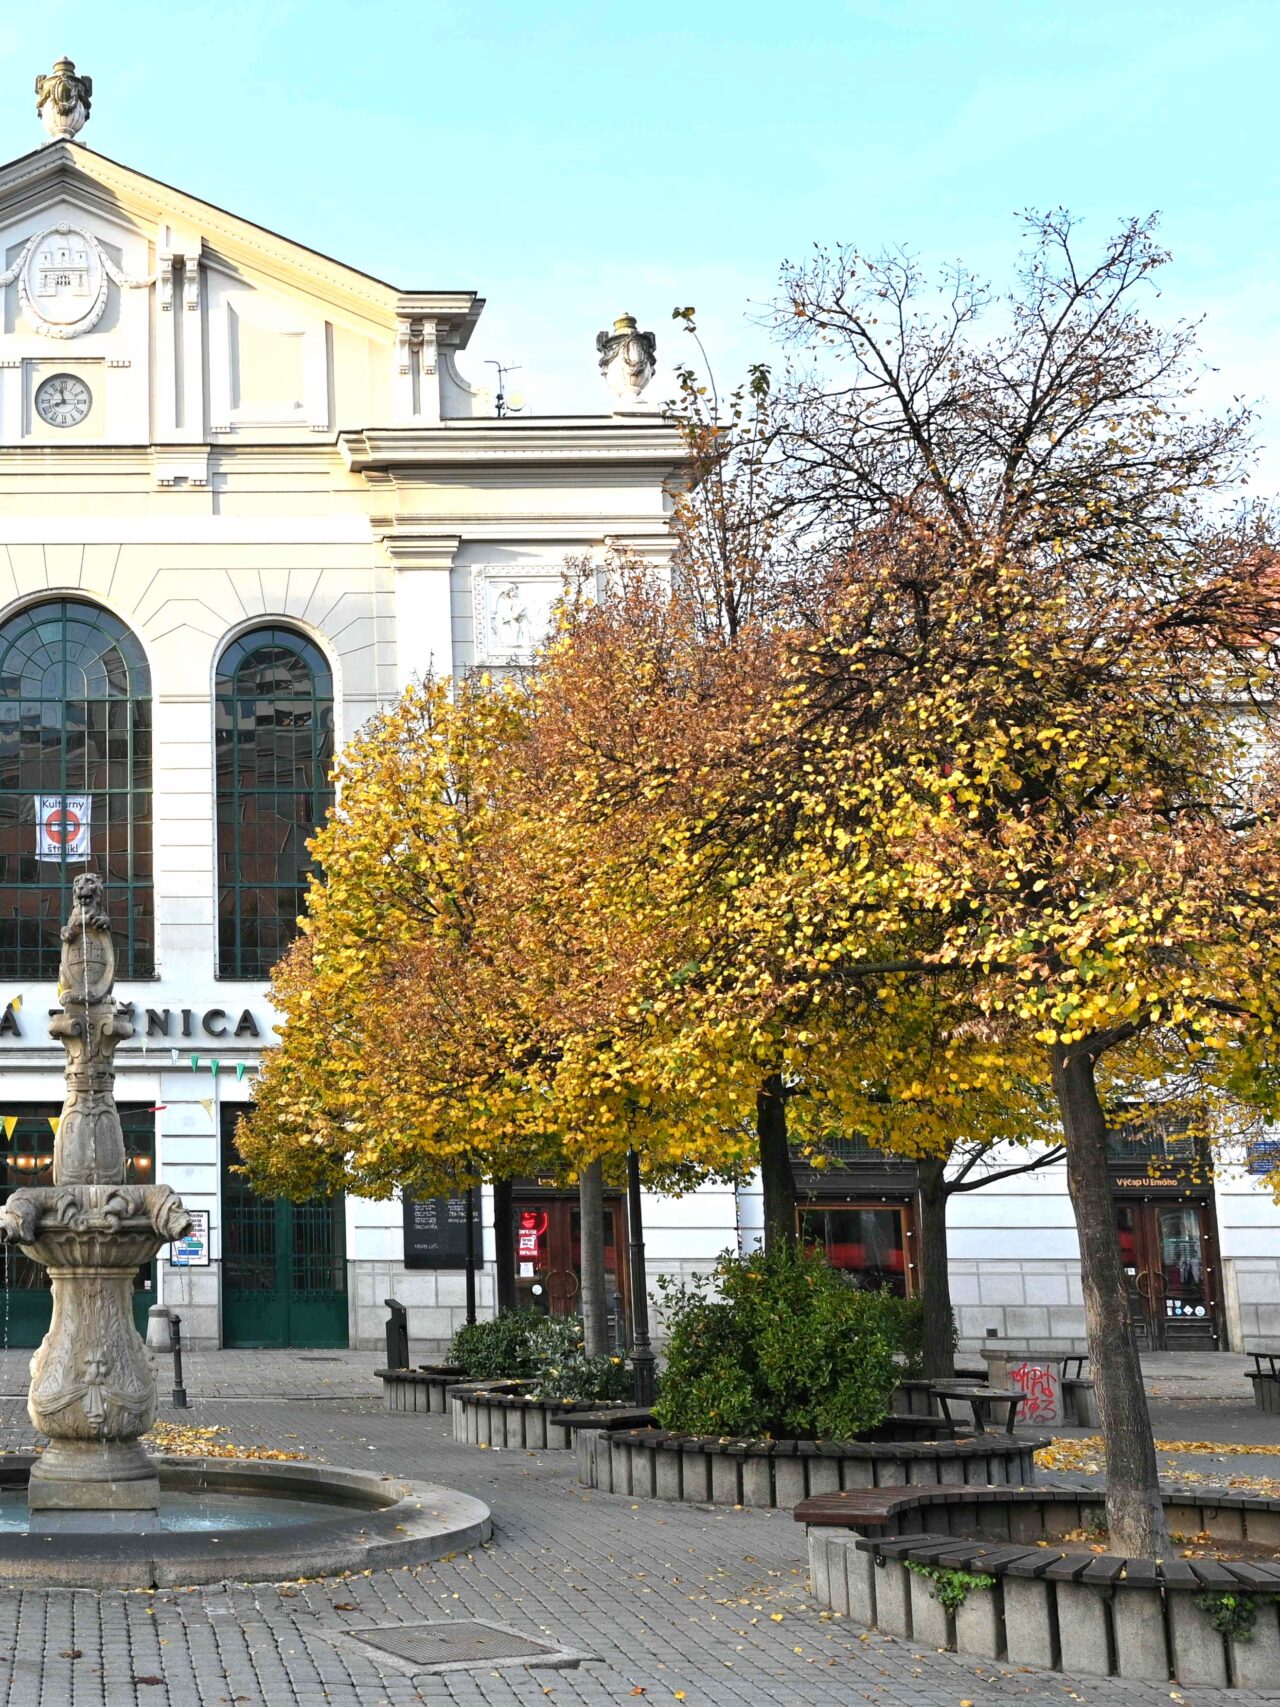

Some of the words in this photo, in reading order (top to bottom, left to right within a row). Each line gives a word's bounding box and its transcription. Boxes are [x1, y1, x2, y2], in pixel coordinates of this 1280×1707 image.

[42, 800, 84, 810] Kultrny
[47, 843, 79, 853] štrjk!
[1142, 1178, 1149, 1186] U
